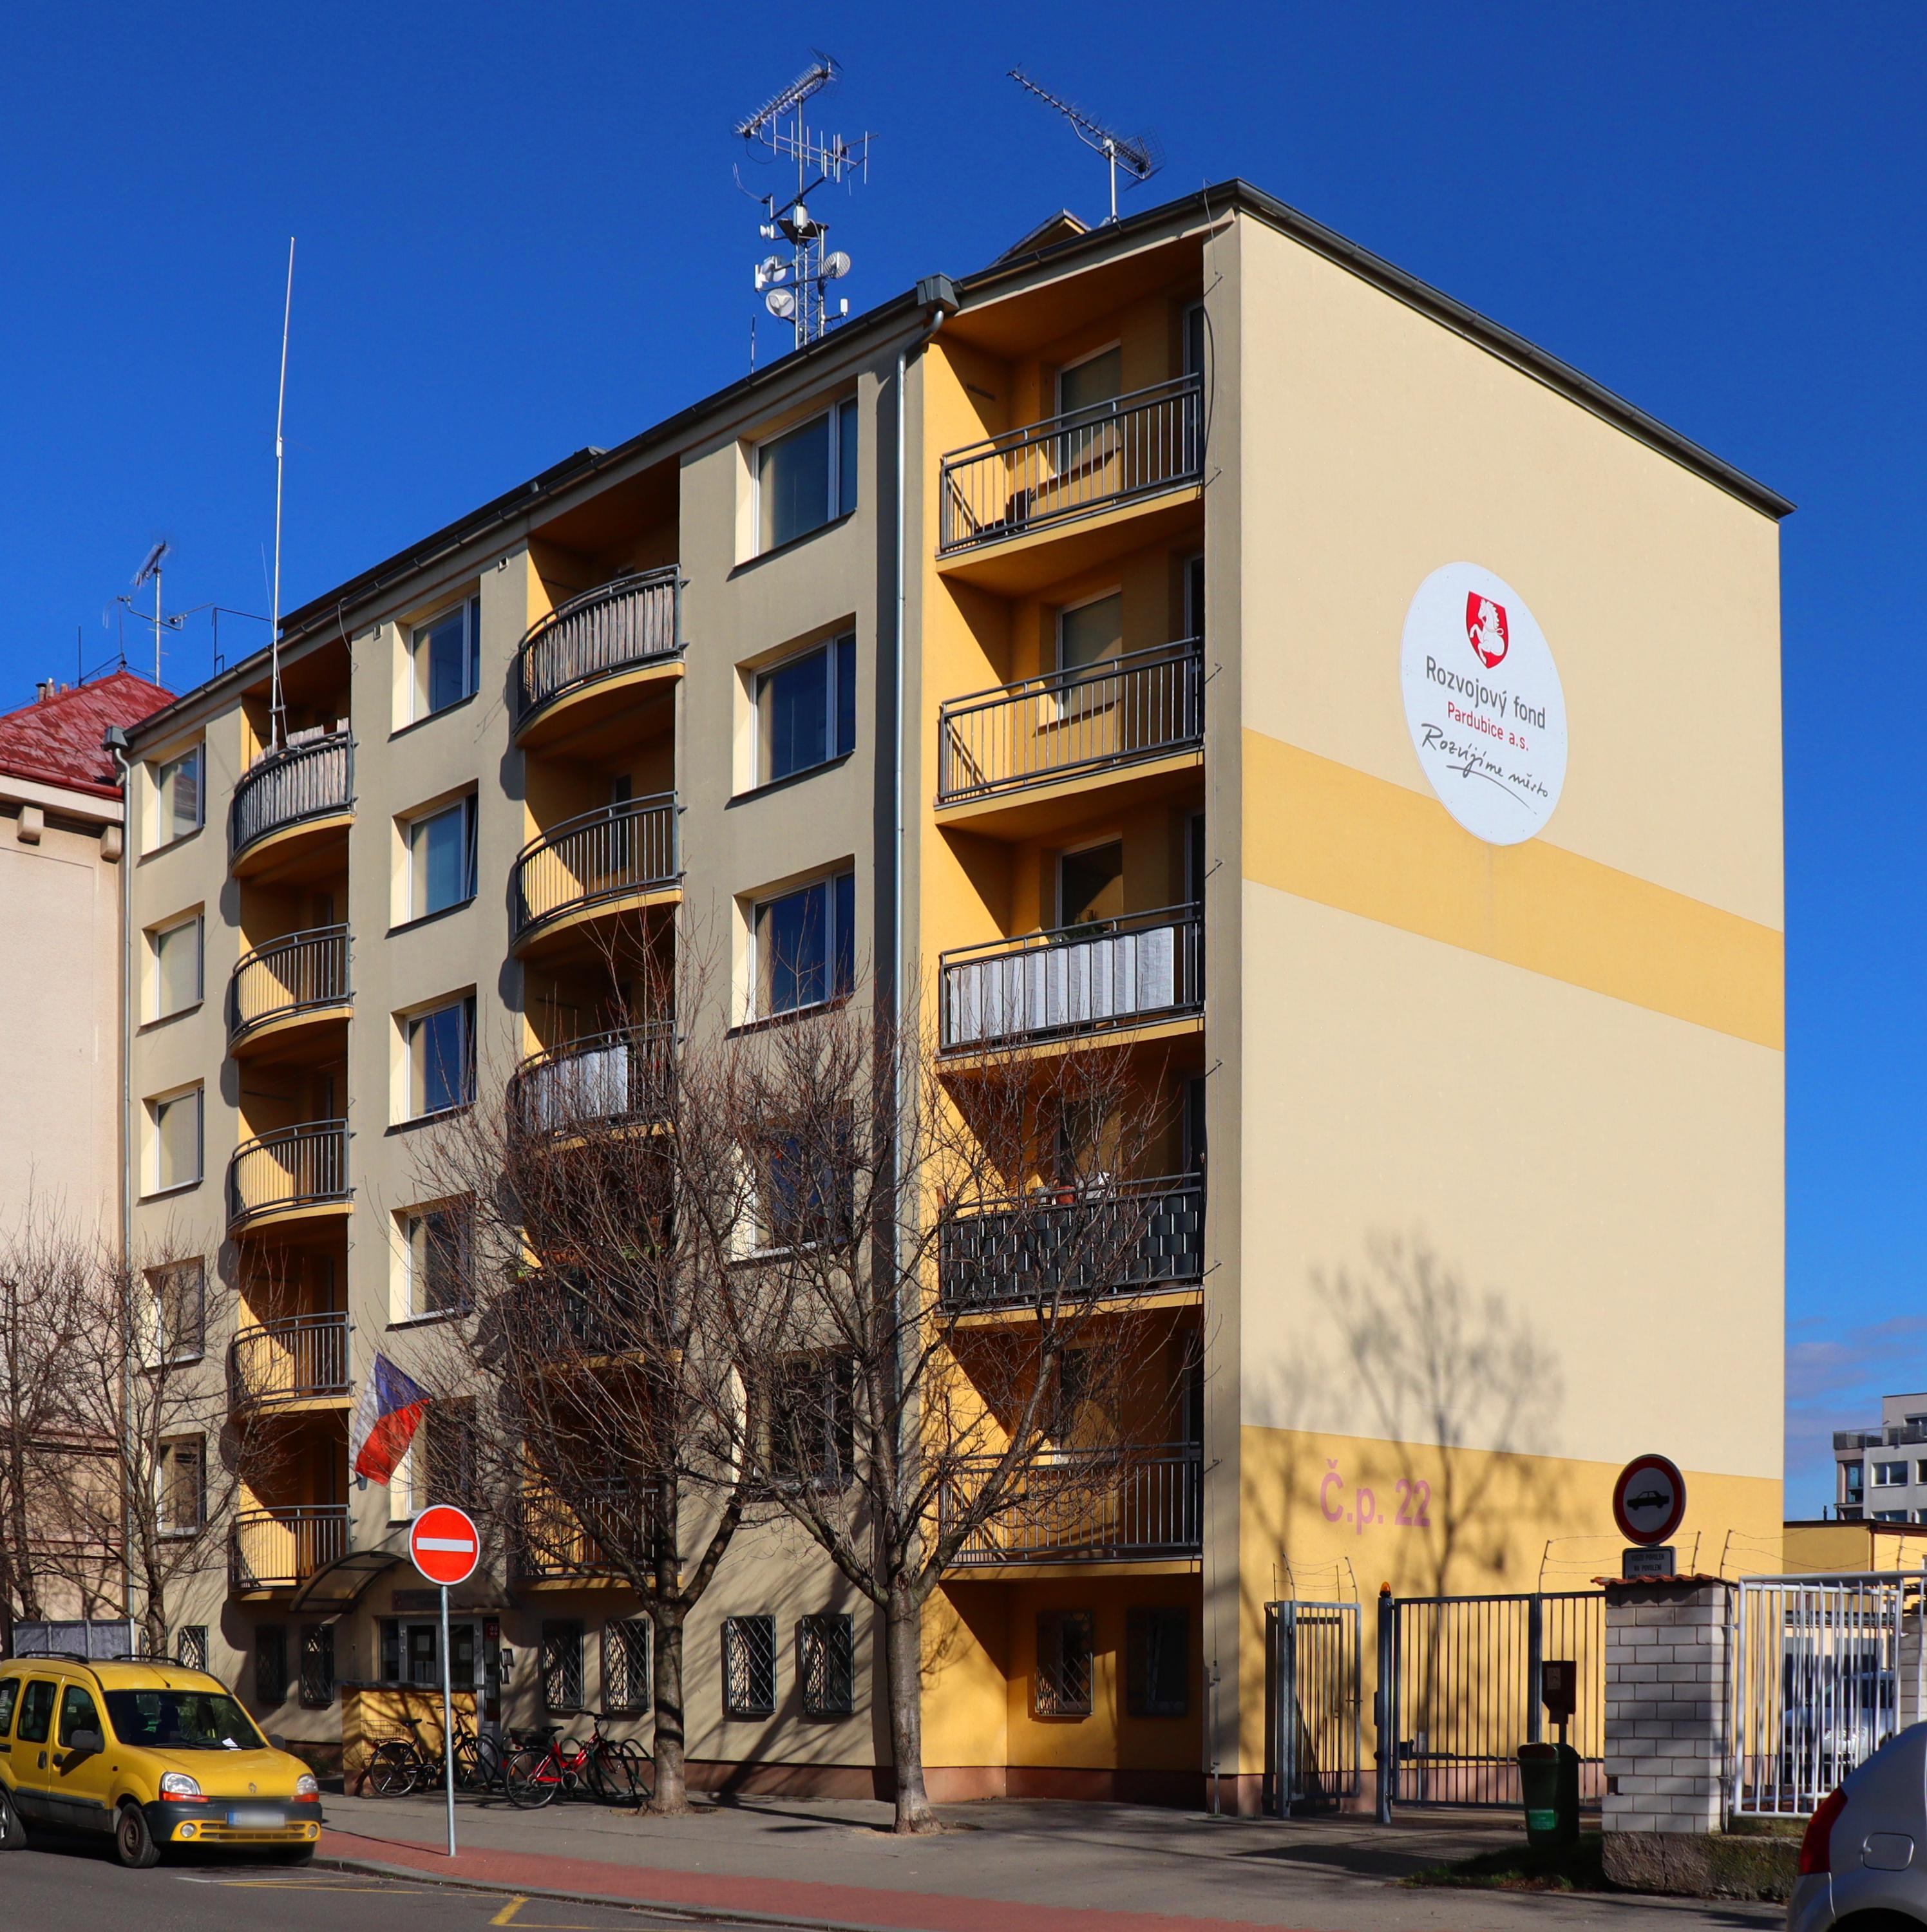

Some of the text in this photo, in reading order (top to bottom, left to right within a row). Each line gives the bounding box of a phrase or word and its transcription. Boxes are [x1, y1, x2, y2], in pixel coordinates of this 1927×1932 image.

[1426, 655, 1546, 730] Rozvojový fond
[1448, 701, 1528, 751] Pardubice a.s.
[1320, 1458, 1431, 1535] Č.p. 22
